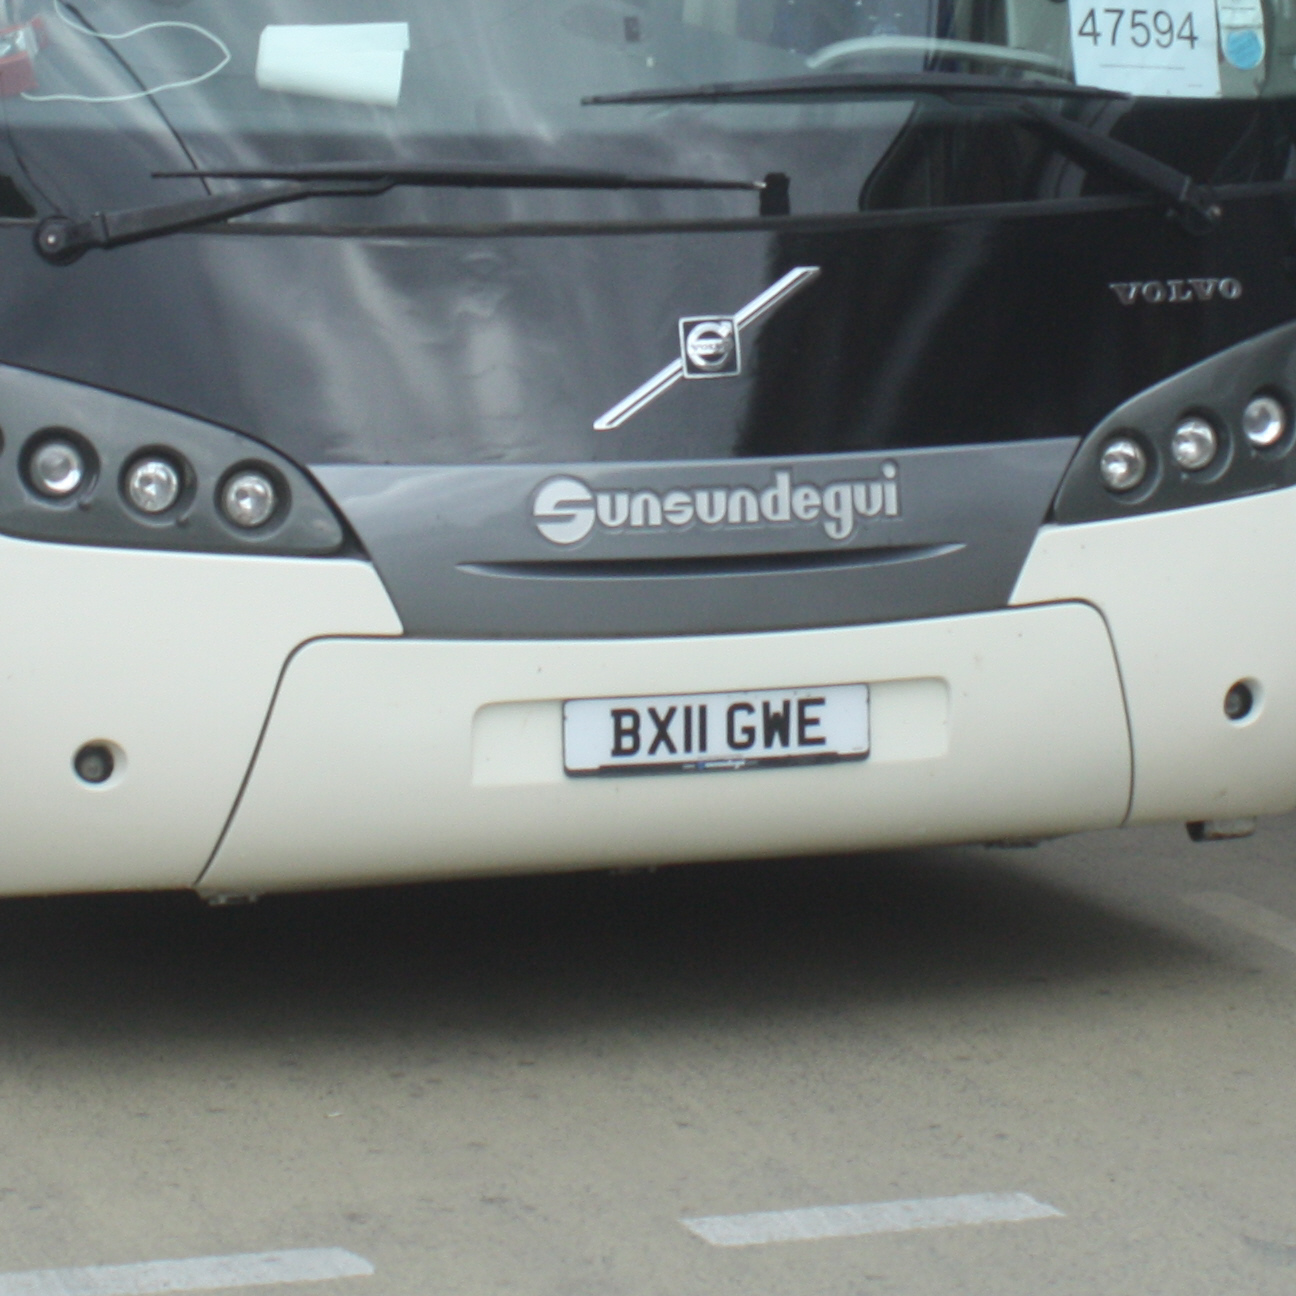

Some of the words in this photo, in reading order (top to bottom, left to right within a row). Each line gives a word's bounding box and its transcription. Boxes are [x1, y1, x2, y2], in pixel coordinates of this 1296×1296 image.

[1078, 8, 1199, 50] 47594
[1108, 277, 1243, 306] VOLVO
[533, 460, 899, 544] Sunsundegui
[610, 704, 707, 757] BX11
[726, 697, 826, 750] GWE
